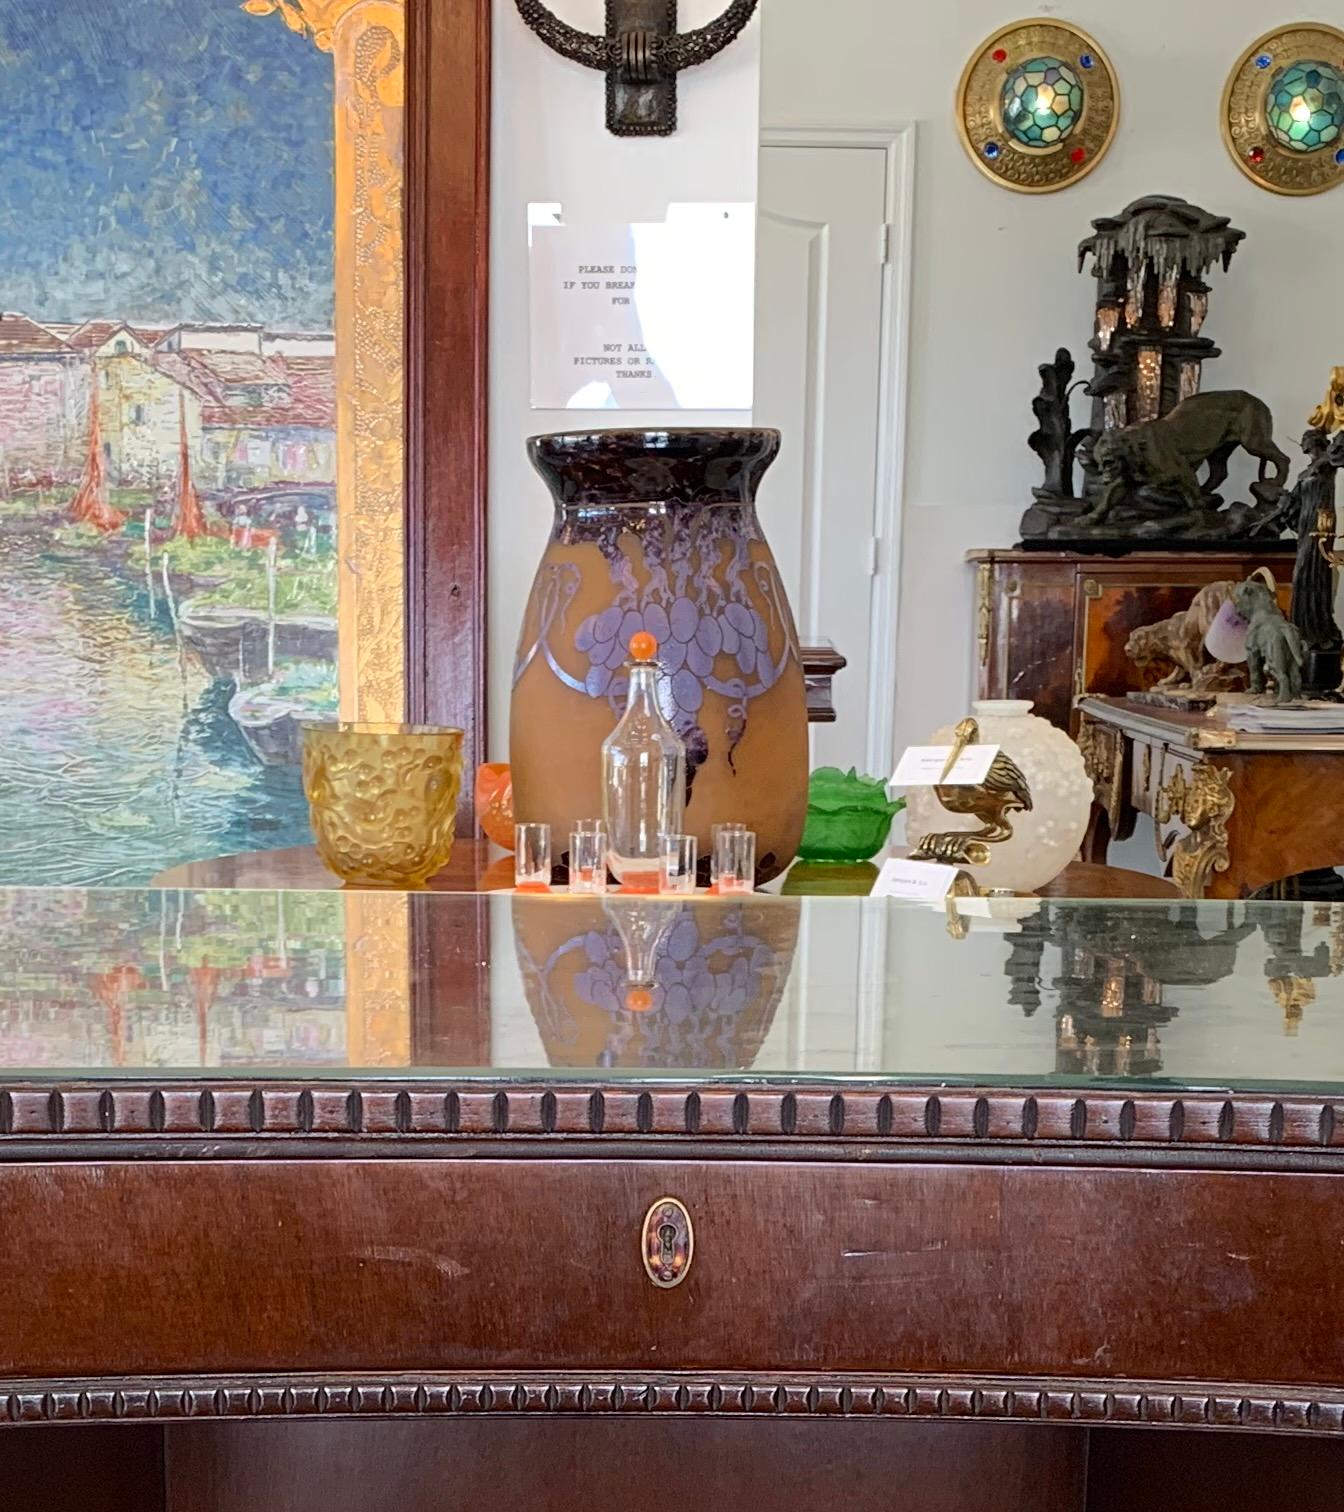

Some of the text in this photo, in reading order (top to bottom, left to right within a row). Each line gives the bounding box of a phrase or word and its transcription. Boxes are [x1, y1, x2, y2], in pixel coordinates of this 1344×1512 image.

[578, 265, 615, 273] PLEASE
[563, 281, 576, 289] IF
[581, 281, 600, 289] YOU
[612, 297, 630, 305] FOR
[603, 343, 647, 352] NOT ALL
[573, 357, 623, 365] PICTURES
[627, 357, 640, 365] OR
[616, 370, 652, 378] THANKS
